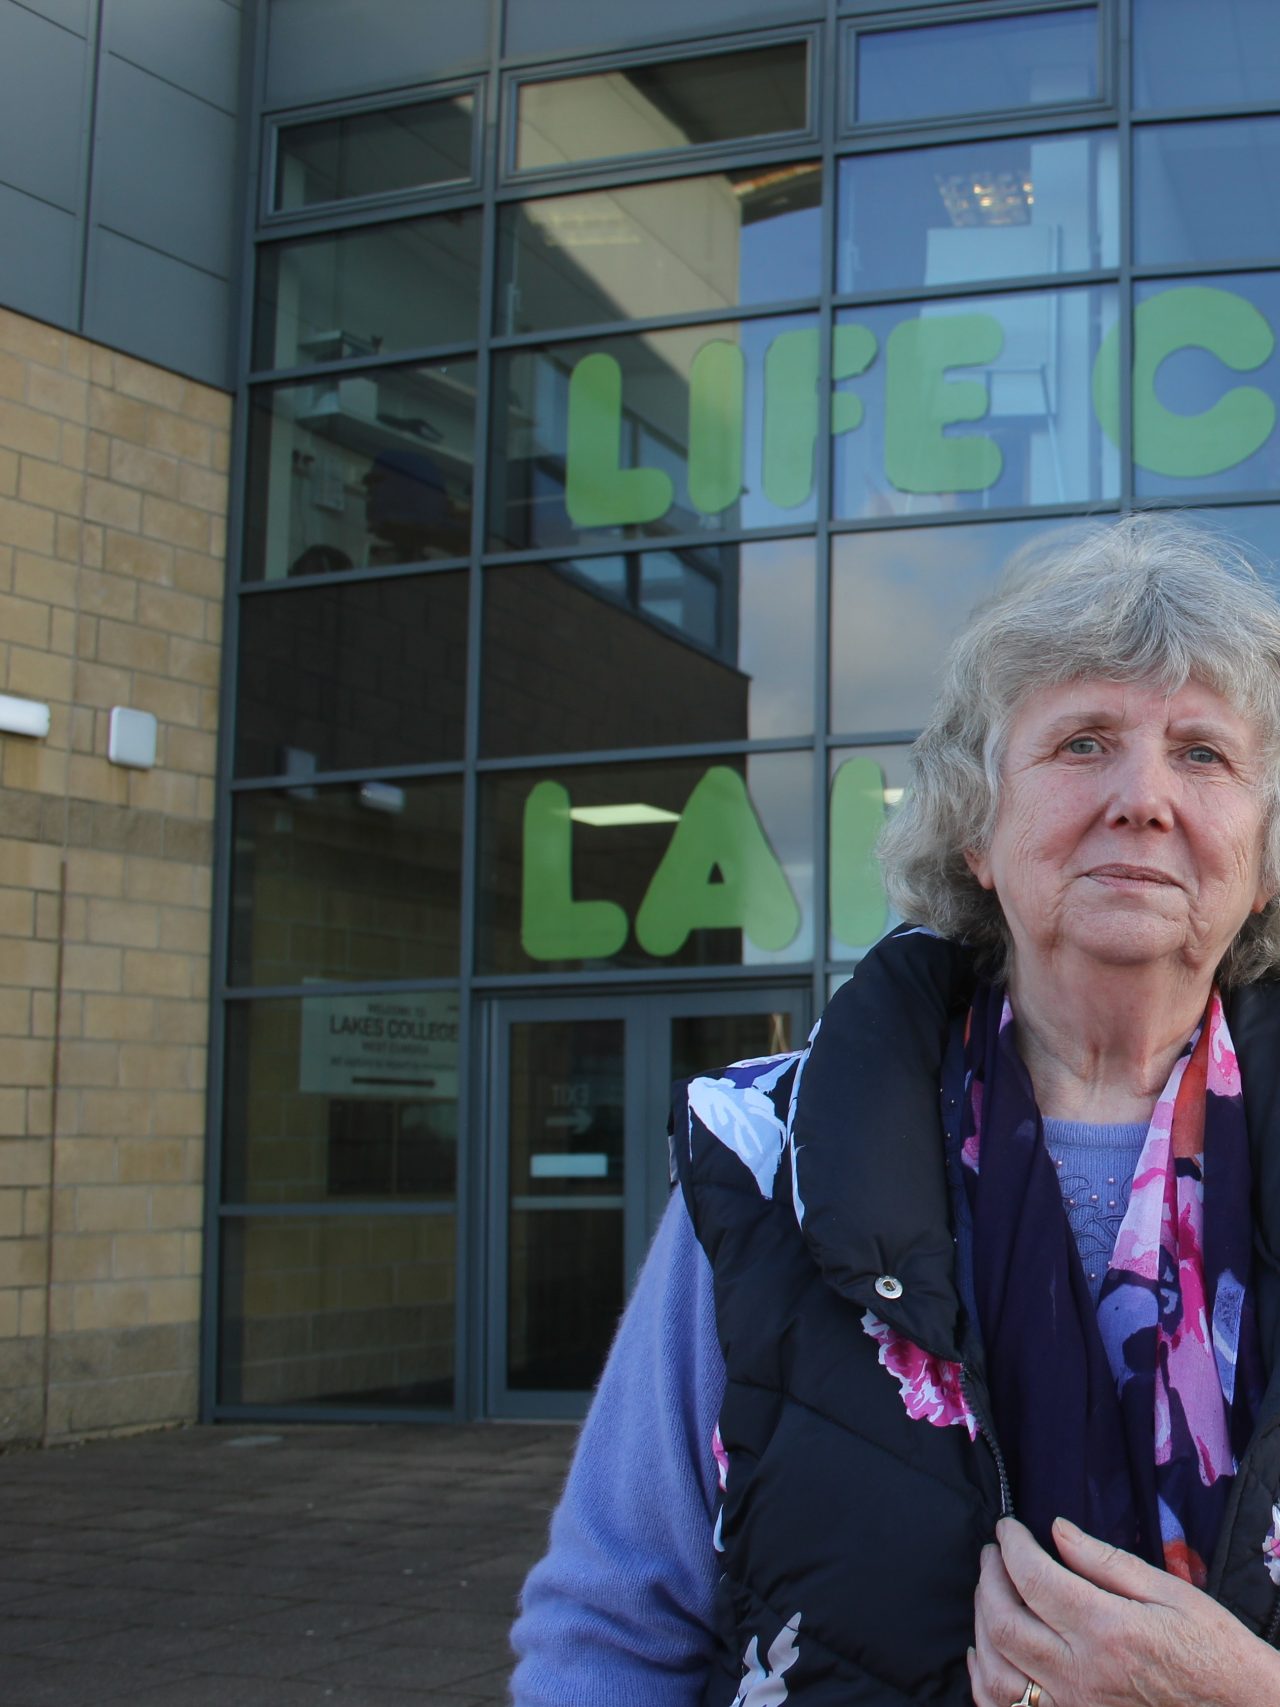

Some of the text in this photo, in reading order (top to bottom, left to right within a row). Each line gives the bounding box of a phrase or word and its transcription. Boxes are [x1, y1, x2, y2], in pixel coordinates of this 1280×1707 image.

[565, 312, 1003, 526] LIFE
[329, 1013, 459, 1043] LAKES COLLEGE
